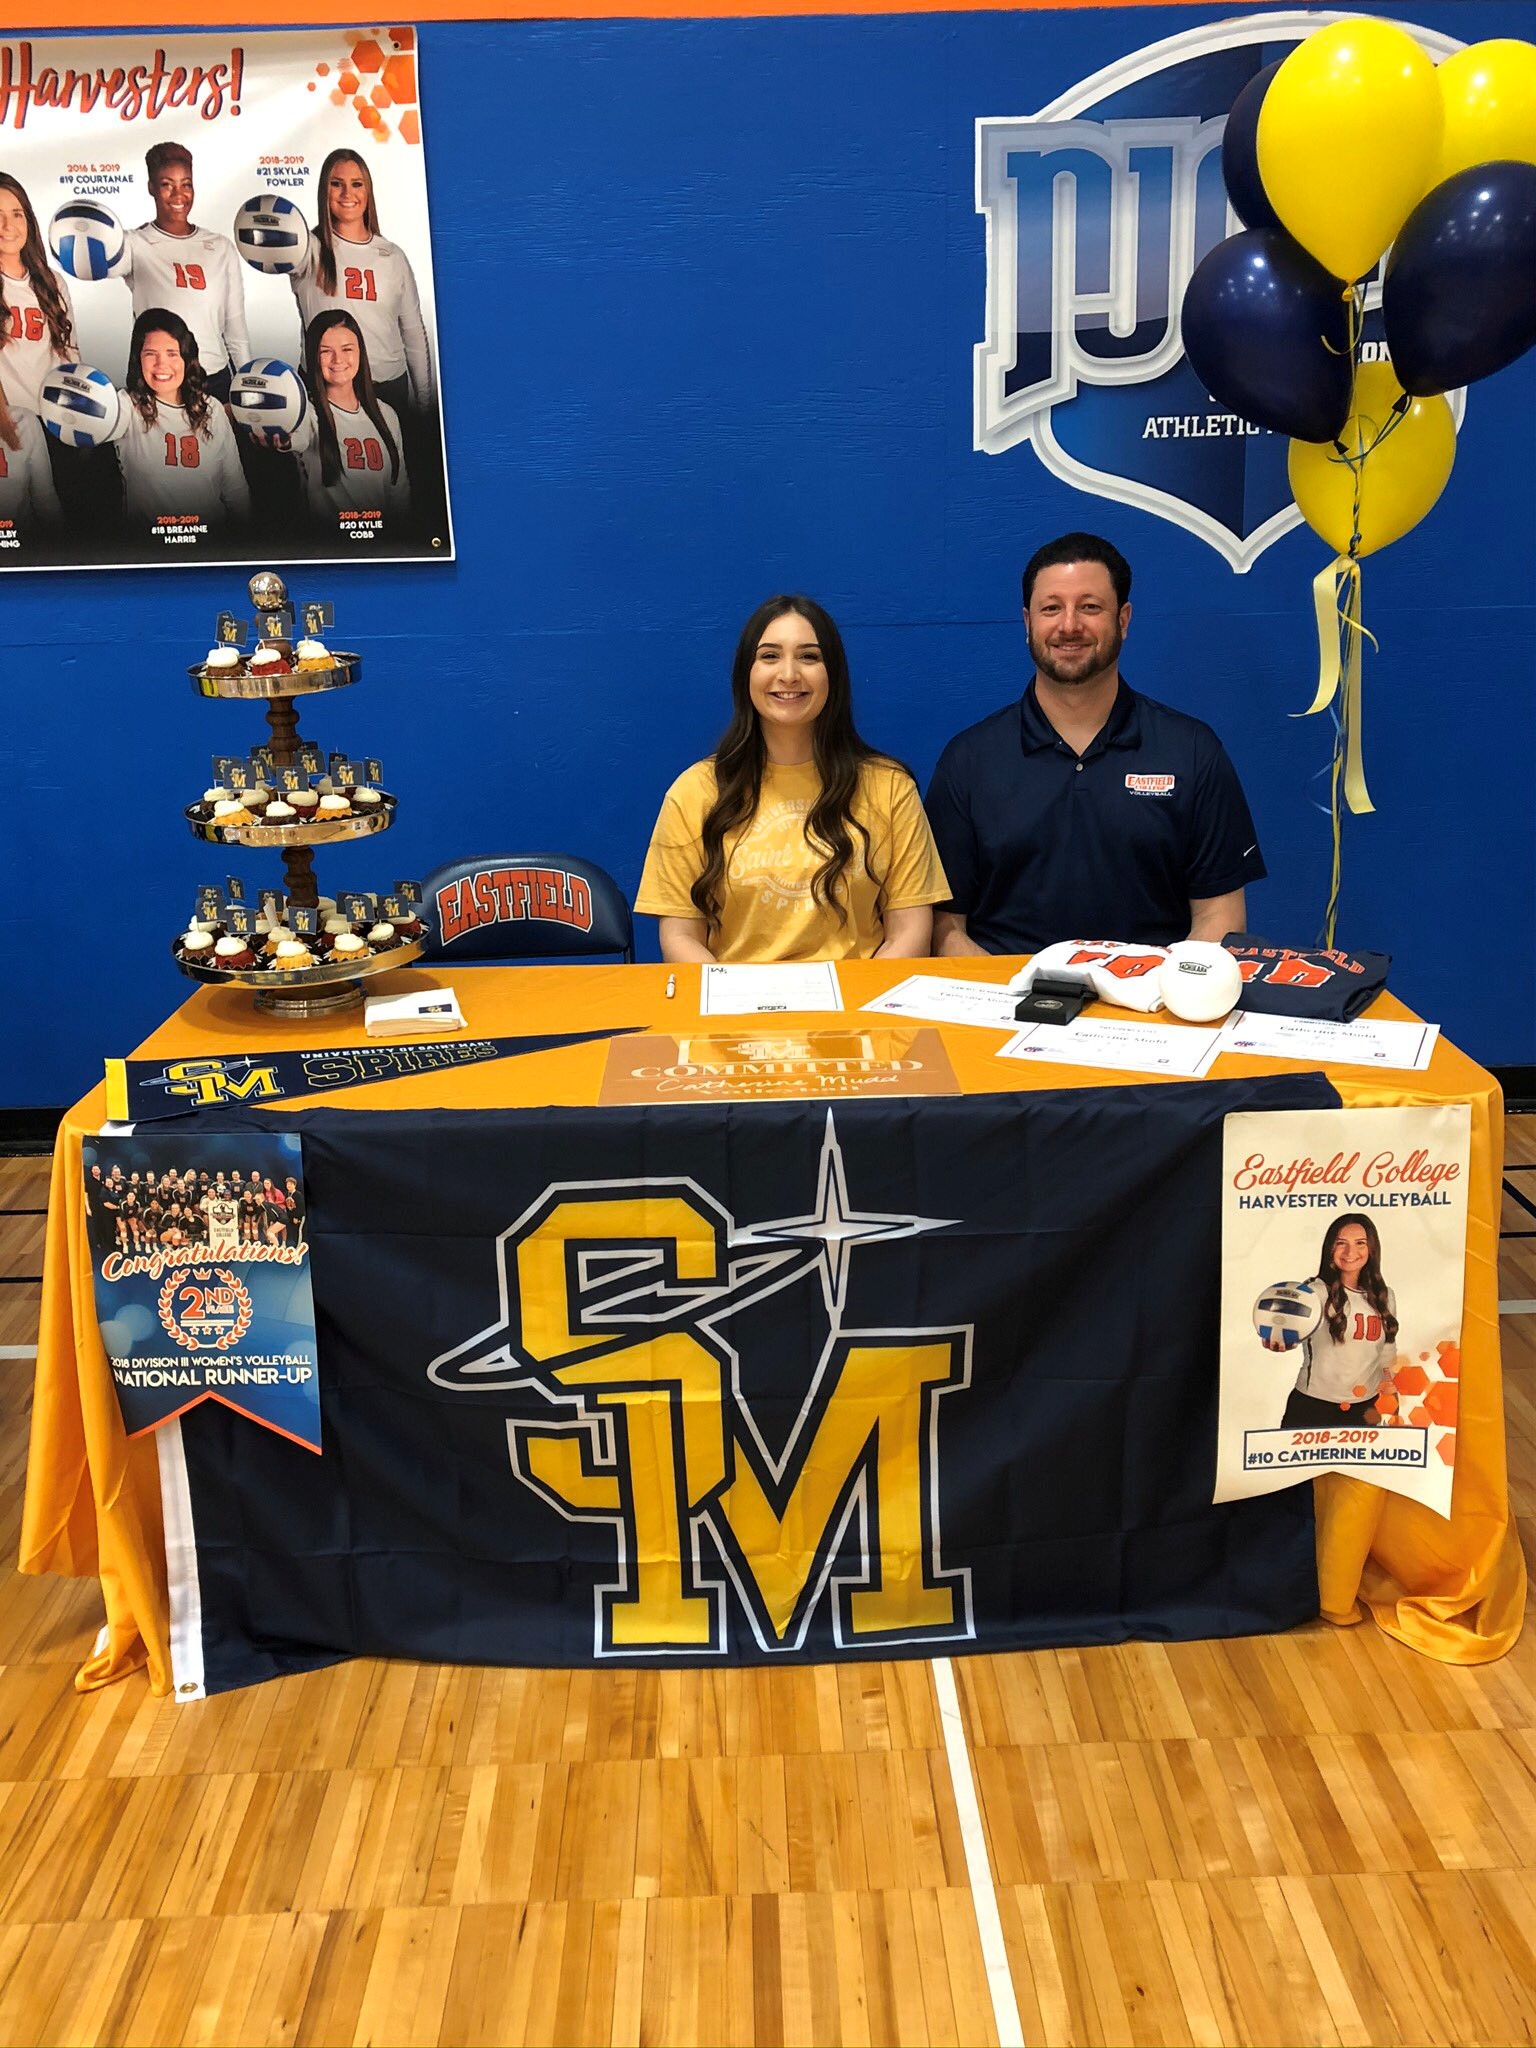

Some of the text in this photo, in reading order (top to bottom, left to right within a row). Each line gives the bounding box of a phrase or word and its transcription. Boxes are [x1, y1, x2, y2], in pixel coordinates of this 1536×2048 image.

[0, 41, 244, 130] Harvesters!
[67, 164, 88, 172] 2016
[100, 163, 120, 172] 2019
[259, 155, 305, 164] 2018-2019
[76, 174, 134, 184] COURTANAE
[273, 166, 310, 176] SKYLAR
[73, 185, 120, 195] CALHOUN
[266, 178, 304, 187] FOWLER
[173, 262, 206, 290] 19
[344, 267, 377, 302] 21
[10, 306, 44, 341] 16
[165, 432, 199, 468] 18
[343, 438, 384, 471] 20
[157, 515, 199, 524] 2018-2019
[339, 510, 382, 519] 2018-2019
[166, 524, 208, 534] BREANNE
[339, 520, 383, 530] #20 KYLIE
[164, 535, 197, 544] HARRIS
[349, 530, 375, 539] COBB
[436, 867, 593, 946] EASTFIELD
[300, 1048, 396, 1060] UNIVERSITY
[418, 1043, 455, 1051] SAINT
[303, 1045, 499, 1088] SPIRES
[631, 1060, 924, 1078] COMMITTED
[1233, 1149, 1460, 1193] Eastfield College
[1239, 1191, 1451, 1209] HARVESTER VOLLEYBALL
[102, 1240, 309, 1282] Congratulations!
[1353, 1313, 1382, 1341] 10
[111, 1354, 311, 1369] 2018 DIVISION III WOMEN'S VOLLEYBALL
[114, 1367, 312, 1387] NATIONAL RUNNER-UP
[1291, 1430, 1380, 1446] 2018-2019
[1247, 1448, 1422, 1465] #10 CATHERINE MUDD
